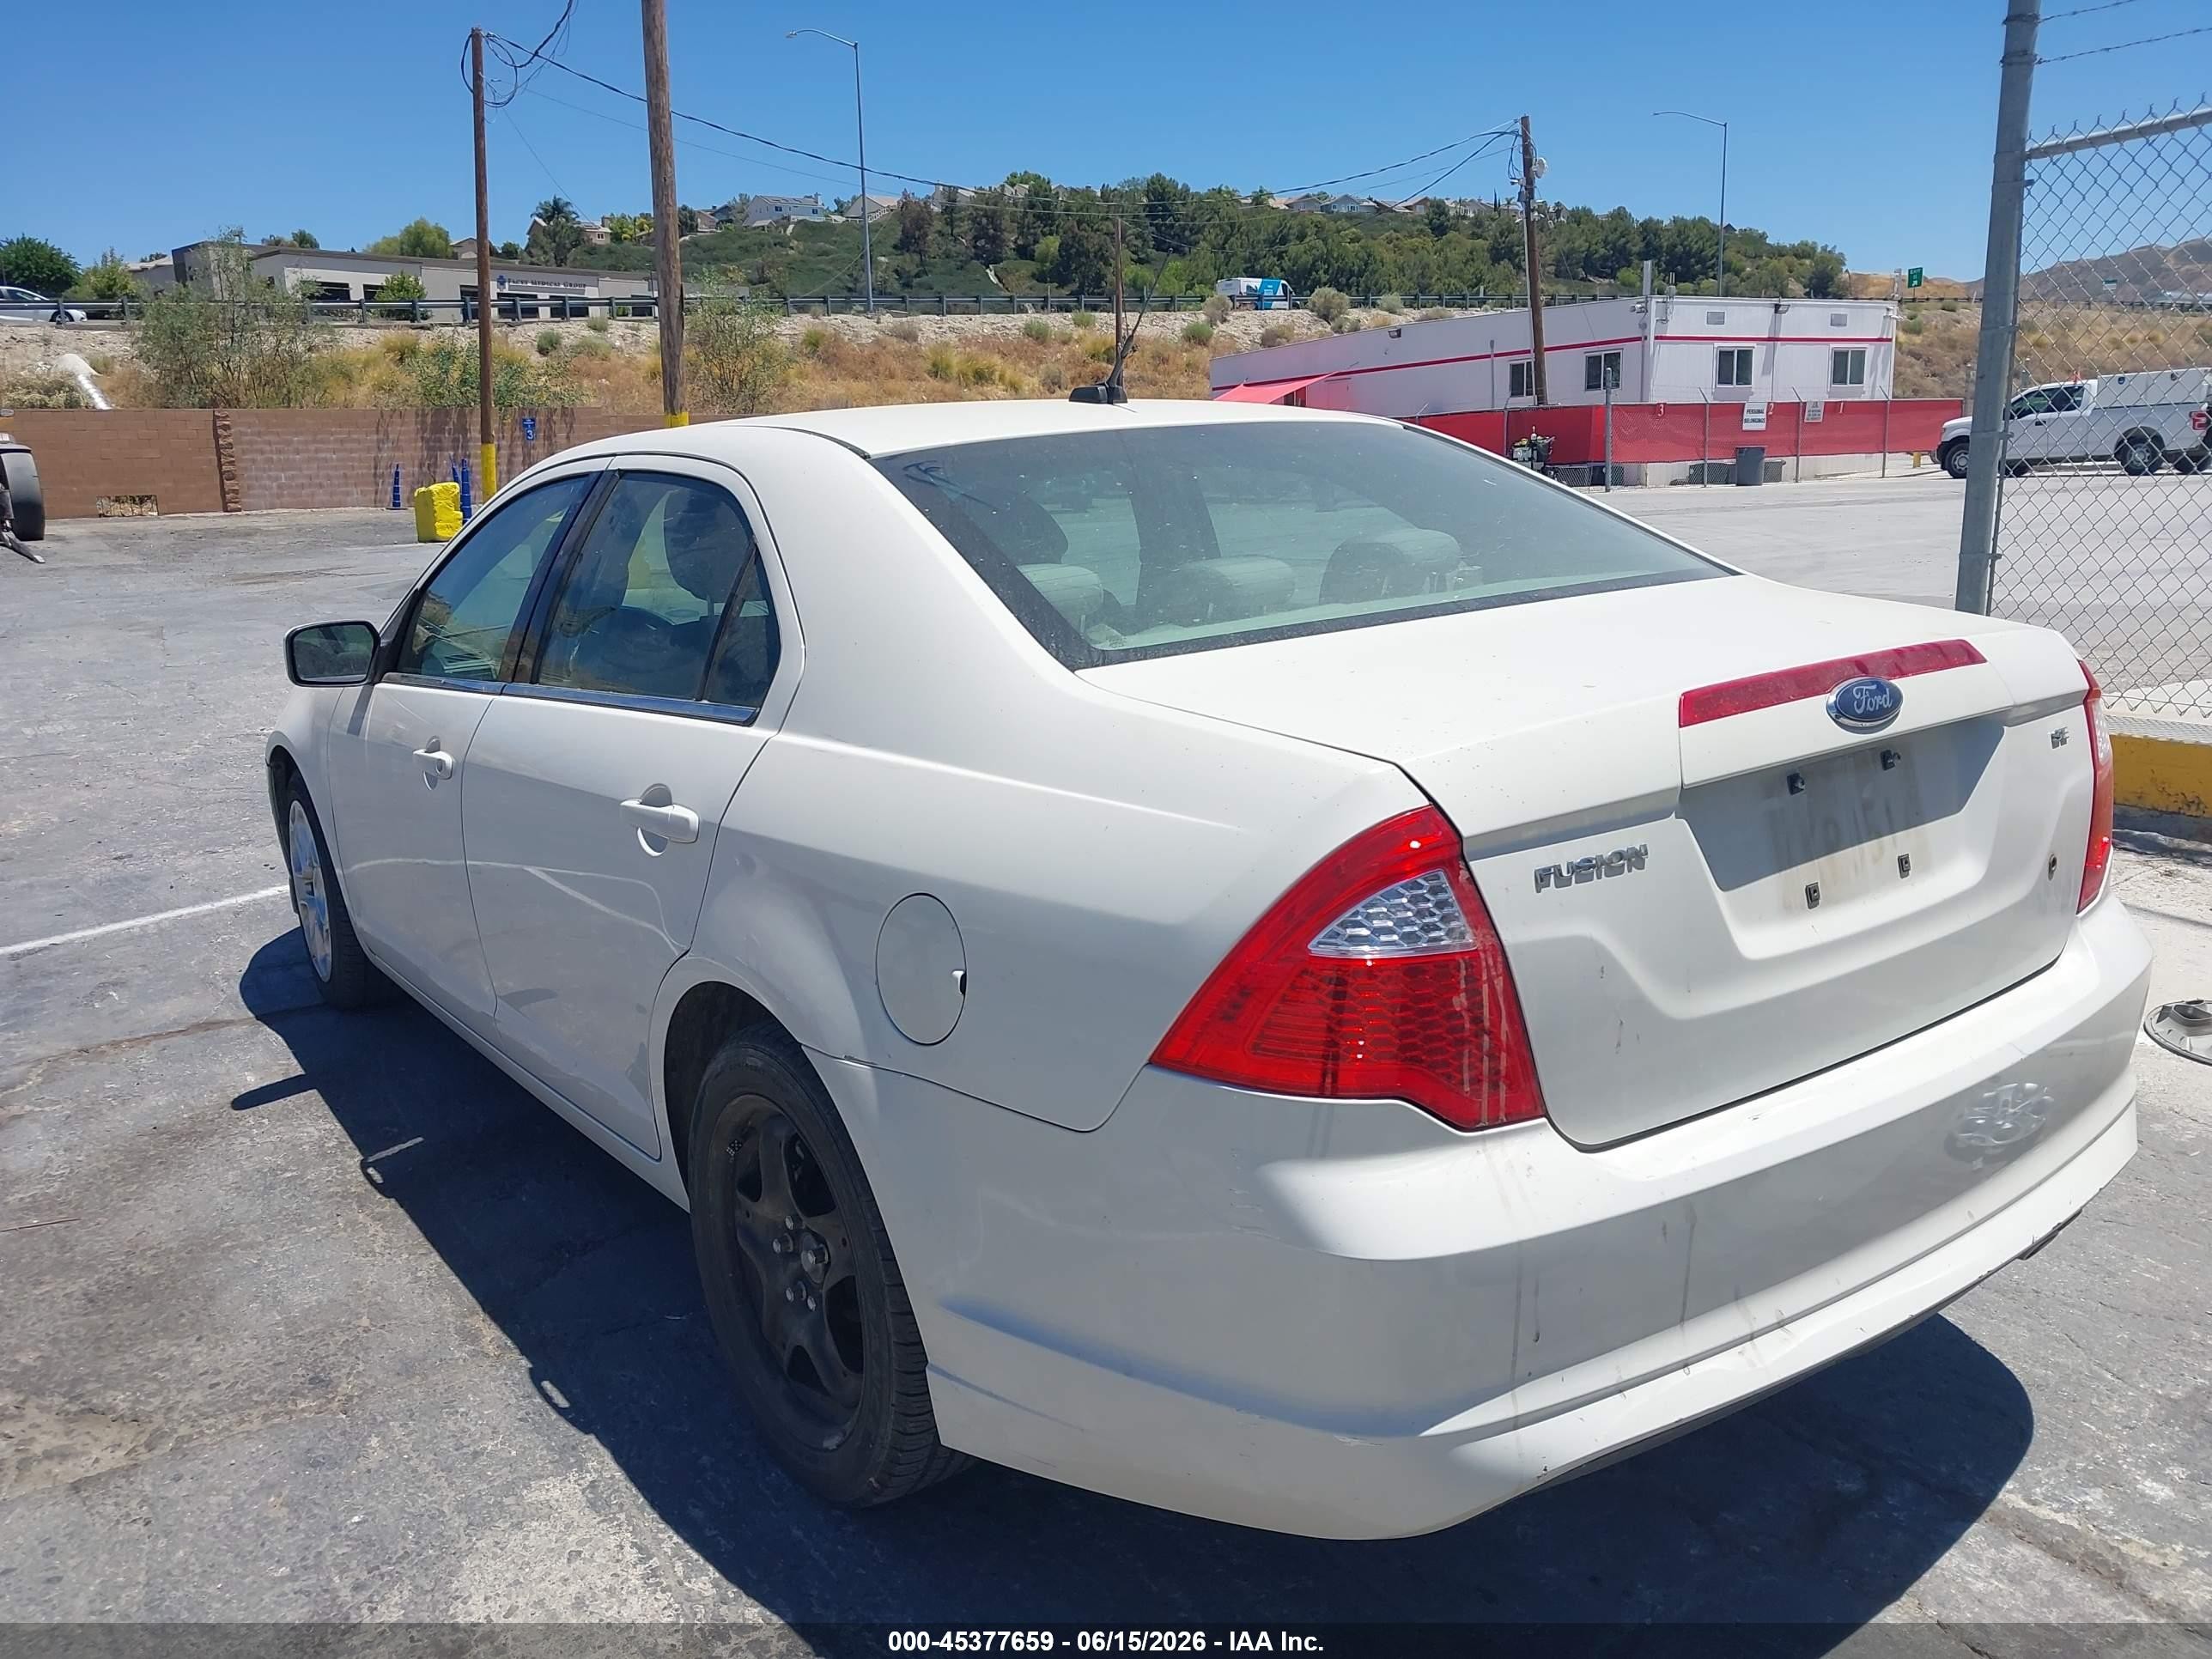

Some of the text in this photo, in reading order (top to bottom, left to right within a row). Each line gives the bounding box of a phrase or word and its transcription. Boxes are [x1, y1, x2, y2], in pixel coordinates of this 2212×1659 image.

[1657, 404, 1664, 416] 3
[1768, 403, 1774, 415] 2
[527, 429, 533, 439] 3
[1853, 684, 1893, 714] Ford
[1534, 844, 1648, 893] FUSION
